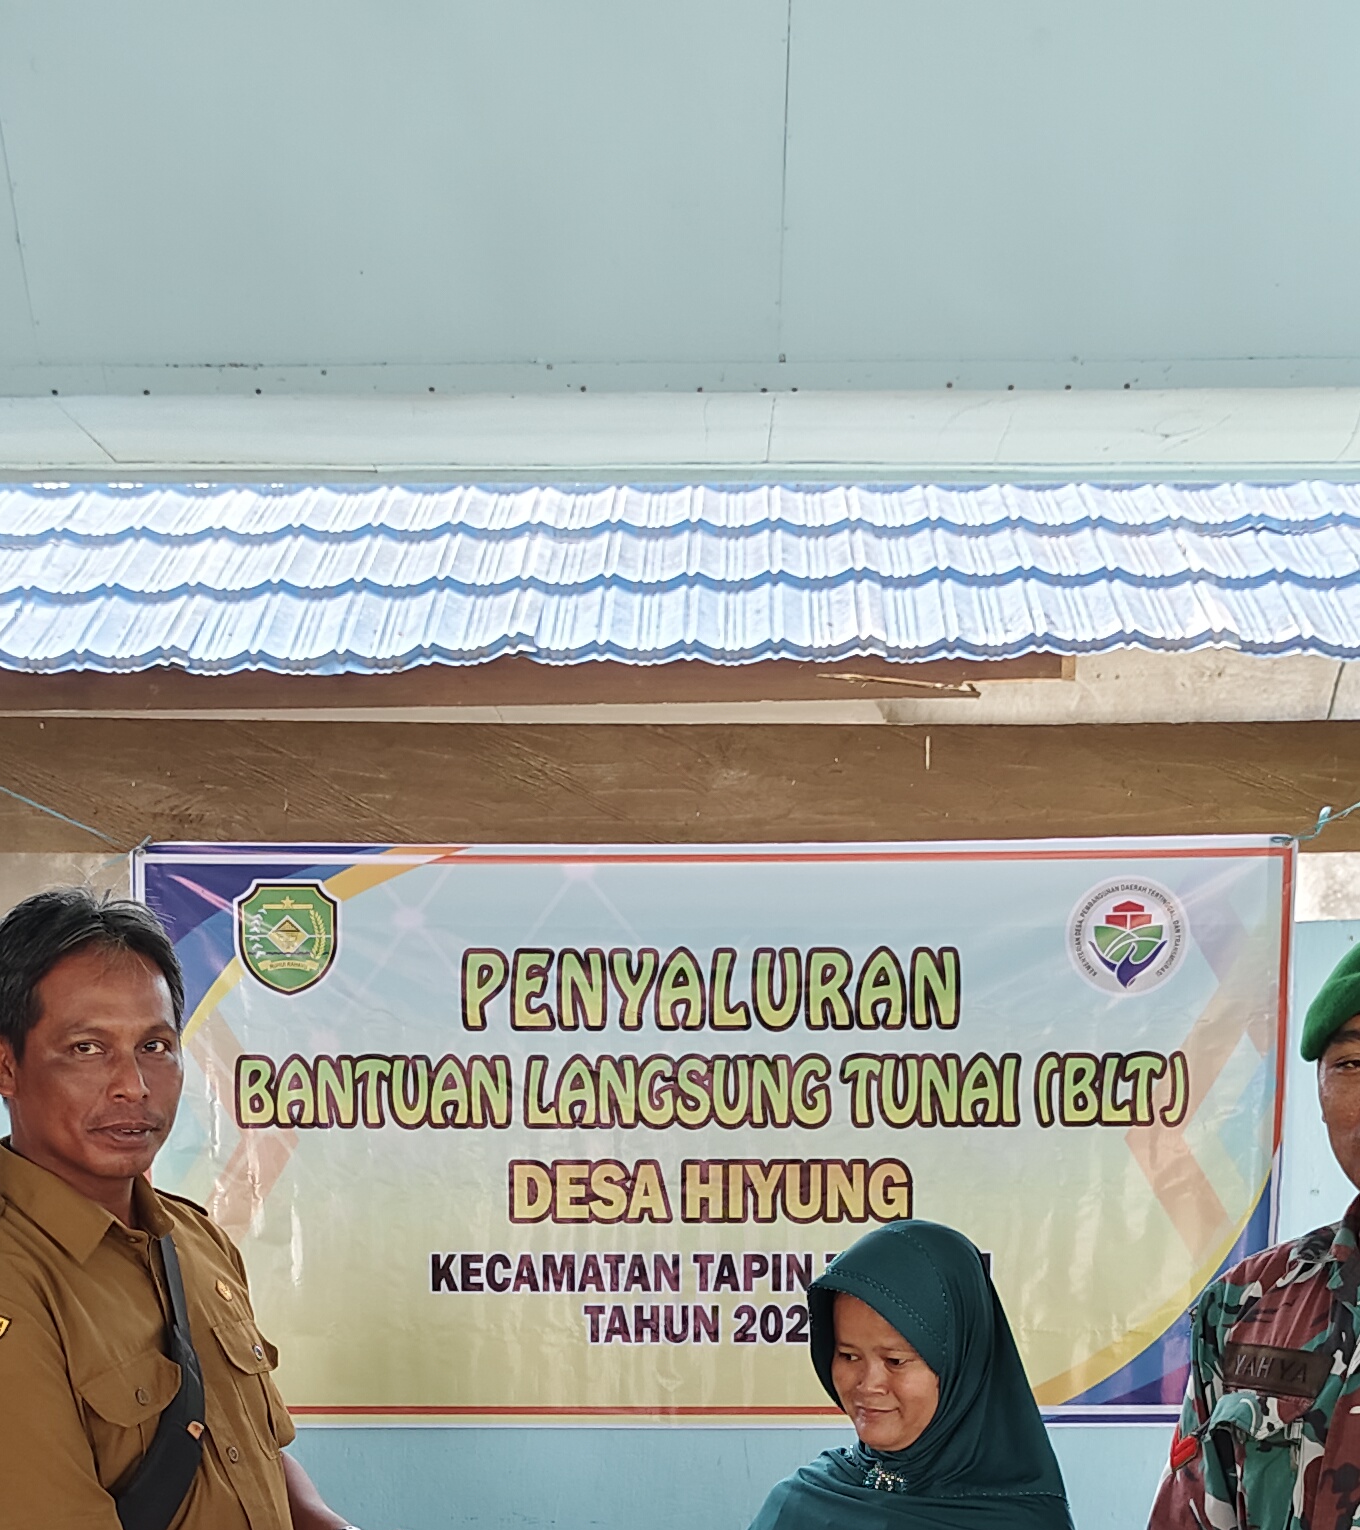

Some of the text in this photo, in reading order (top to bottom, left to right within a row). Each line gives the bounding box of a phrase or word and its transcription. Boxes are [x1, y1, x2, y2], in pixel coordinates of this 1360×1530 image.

[462, 947, 960, 1031] PENYALURAN
[235, 1050, 1189, 1130] BANTUAN LANGSUNG TUNAI (BLT)
[509, 1158, 913, 1223] DESA HIYUNG
[431, 1254, 680, 1293] KECAMATAN
[693, 1253, 811, 1292] TAPIN
[584, 1304, 809, 1343] TAHUN 202
